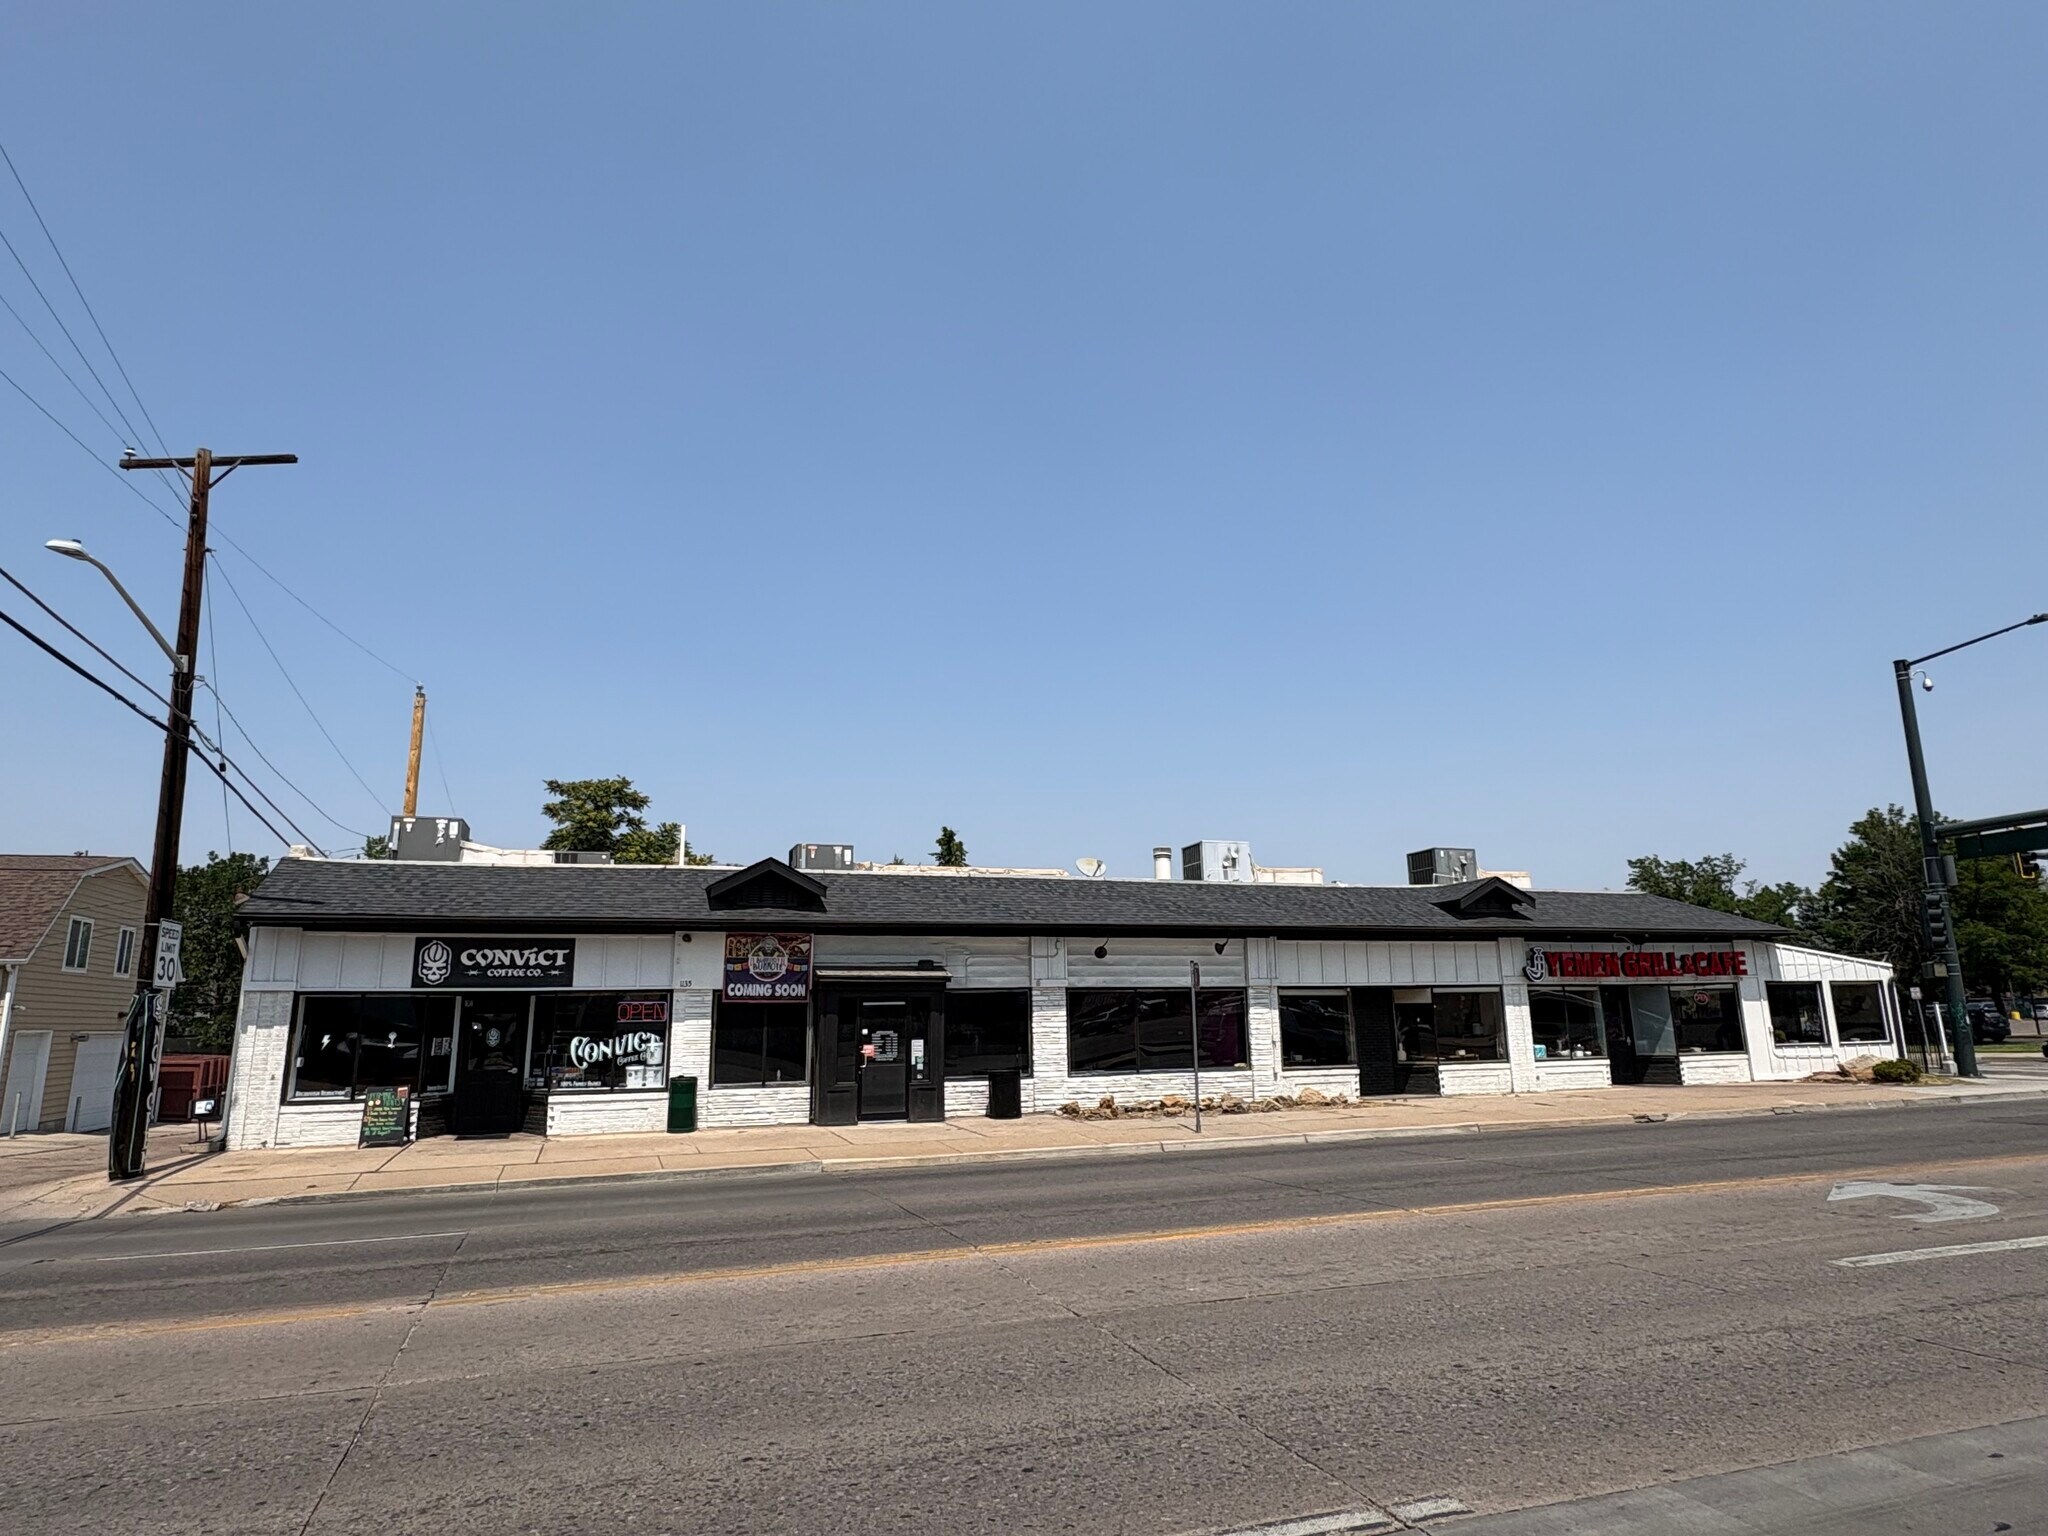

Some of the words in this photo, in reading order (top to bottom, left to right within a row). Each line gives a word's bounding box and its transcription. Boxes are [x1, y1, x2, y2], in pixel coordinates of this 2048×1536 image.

[161, 926, 180, 940] SPEED
[161, 941, 177, 954] LIMIT
[460, 947, 570, 967] CONVICT
[1543, 951, 1621, 977] YEMEN
[1620, 951, 1684, 977] GRILL
[1692, 951, 1748, 977] CAFE
[157, 955, 176, 982] 30
[486, 968, 526, 978] COFFEE
[526, 968, 545, 977] CO.
[680, 979, 693, 988] 1135
[727, 983, 772, 997] COMING
[775, 983, 806, 997] SOON
[617, 1003, 667, 1021] OPEN
[570, 1031, 661, 1069] CONVICT
